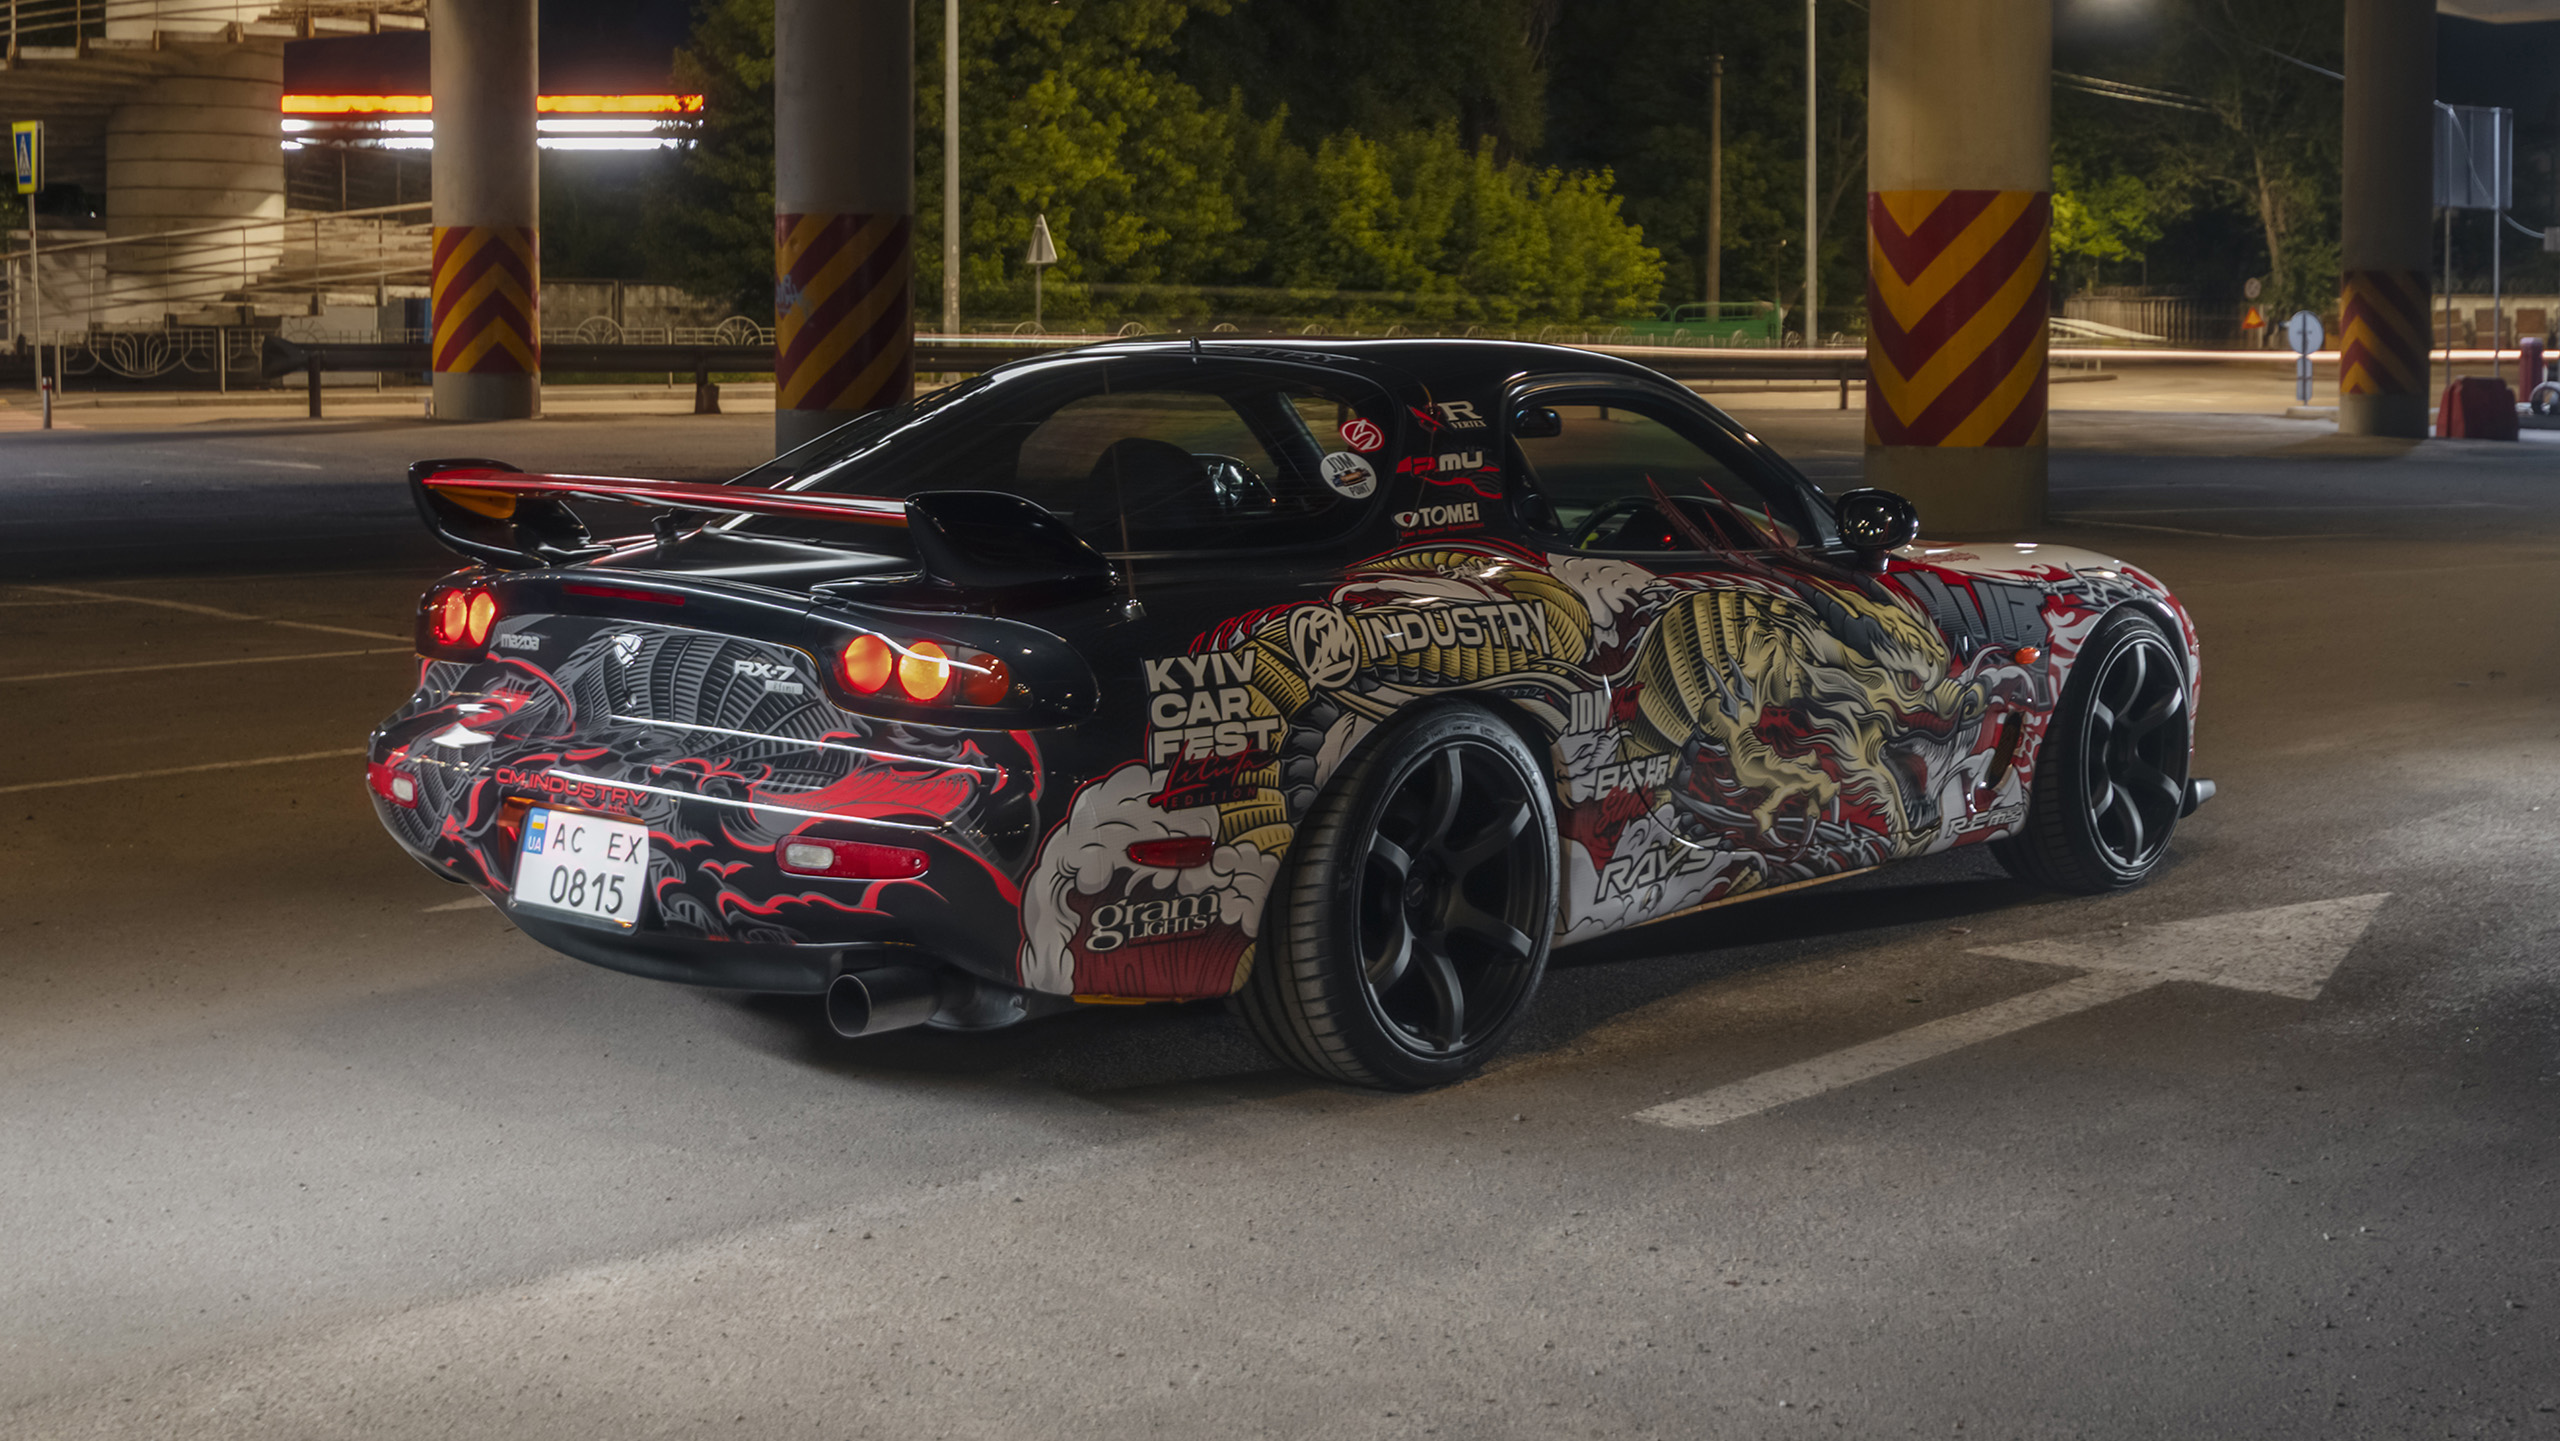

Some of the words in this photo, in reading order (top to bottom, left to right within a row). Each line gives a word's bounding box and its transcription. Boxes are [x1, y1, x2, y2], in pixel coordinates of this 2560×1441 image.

[1450, 419, 1487, 429] VERTEX
[1327, 452, 1356, 473] JDM
[1348, 482, 1371, 497] POINT
[1419, 502, 1479, 527] TOMEI
[1359, 601, 1550, 661] INDUSTRY
[734, 660, 796, 681] RX-7
[1144, 650, 1255, 692] KYIV
[1151, 687, 1251, 728] CAR
[1569, 689, 1614, 736] JDM
[1154, 718, 1279, 765] FEST
[1171, 786, 1257, 808] EDITION
[528, 836, 542, 852] UA
[552, 823, 585, 853] AC
[607, 832, 643, 864] EX
[1597, 836, 1722, 901] RAYS
[550, 865, 625, 914] 0815
[1086, 893, 1219, 951] gram
[1129, 914, 1208, 939] LIGHTS
